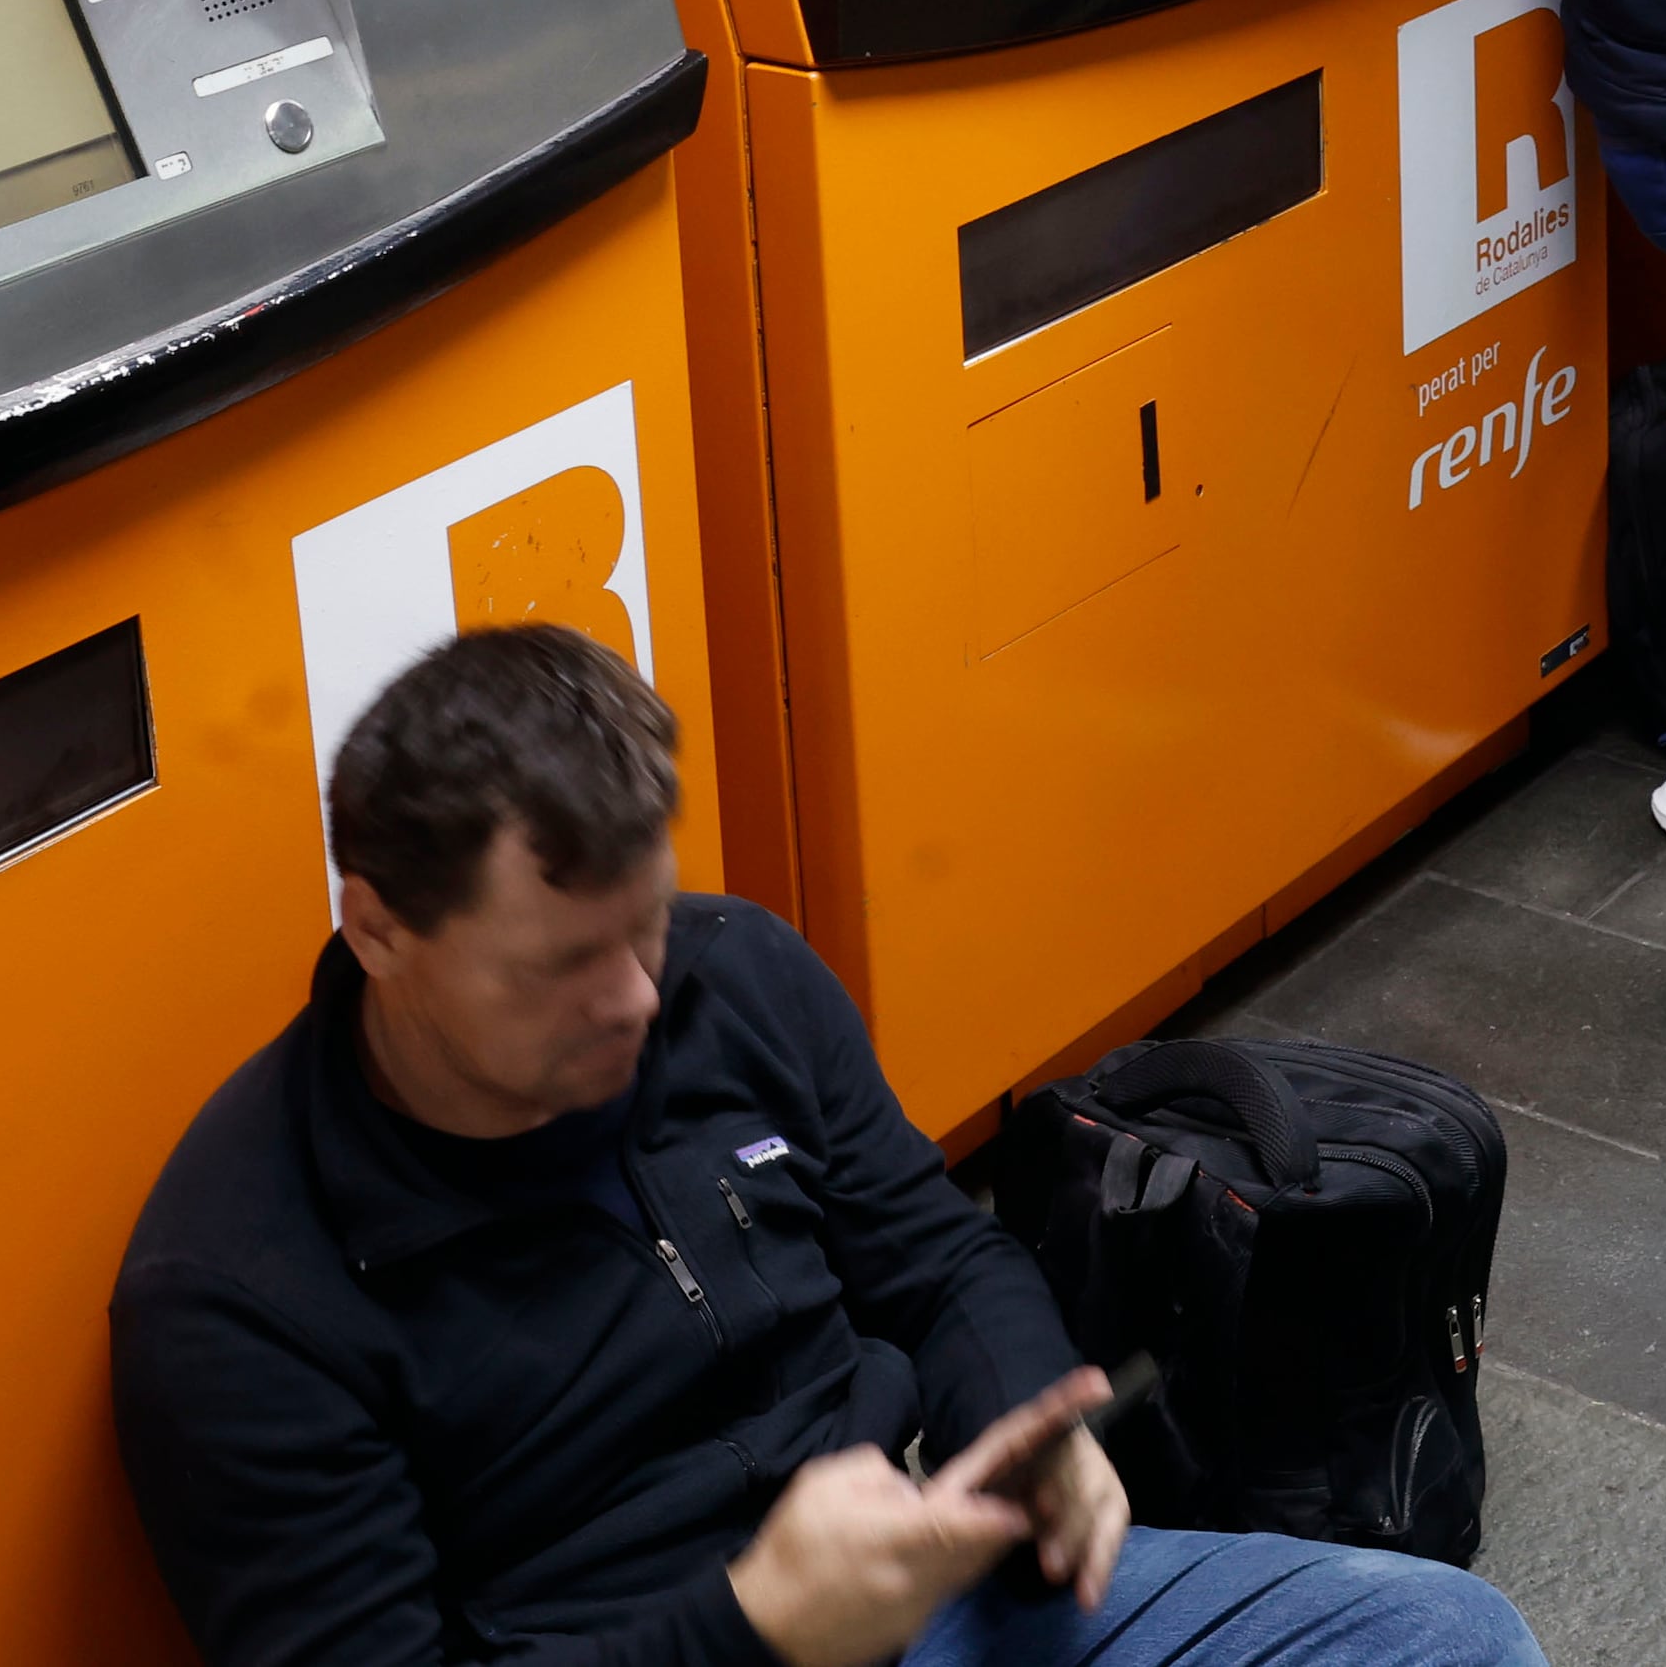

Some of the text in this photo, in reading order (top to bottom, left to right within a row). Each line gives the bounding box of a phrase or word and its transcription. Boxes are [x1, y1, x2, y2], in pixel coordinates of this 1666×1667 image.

[1474, 6, 1571, 225] R
[1475, 245, 1548, 296] de Catalunya
[1476, 202, 1570, 273] Rodalies
[1471, 340, 1501, 389] per
[1408, 345, 1578, 511] renfe
